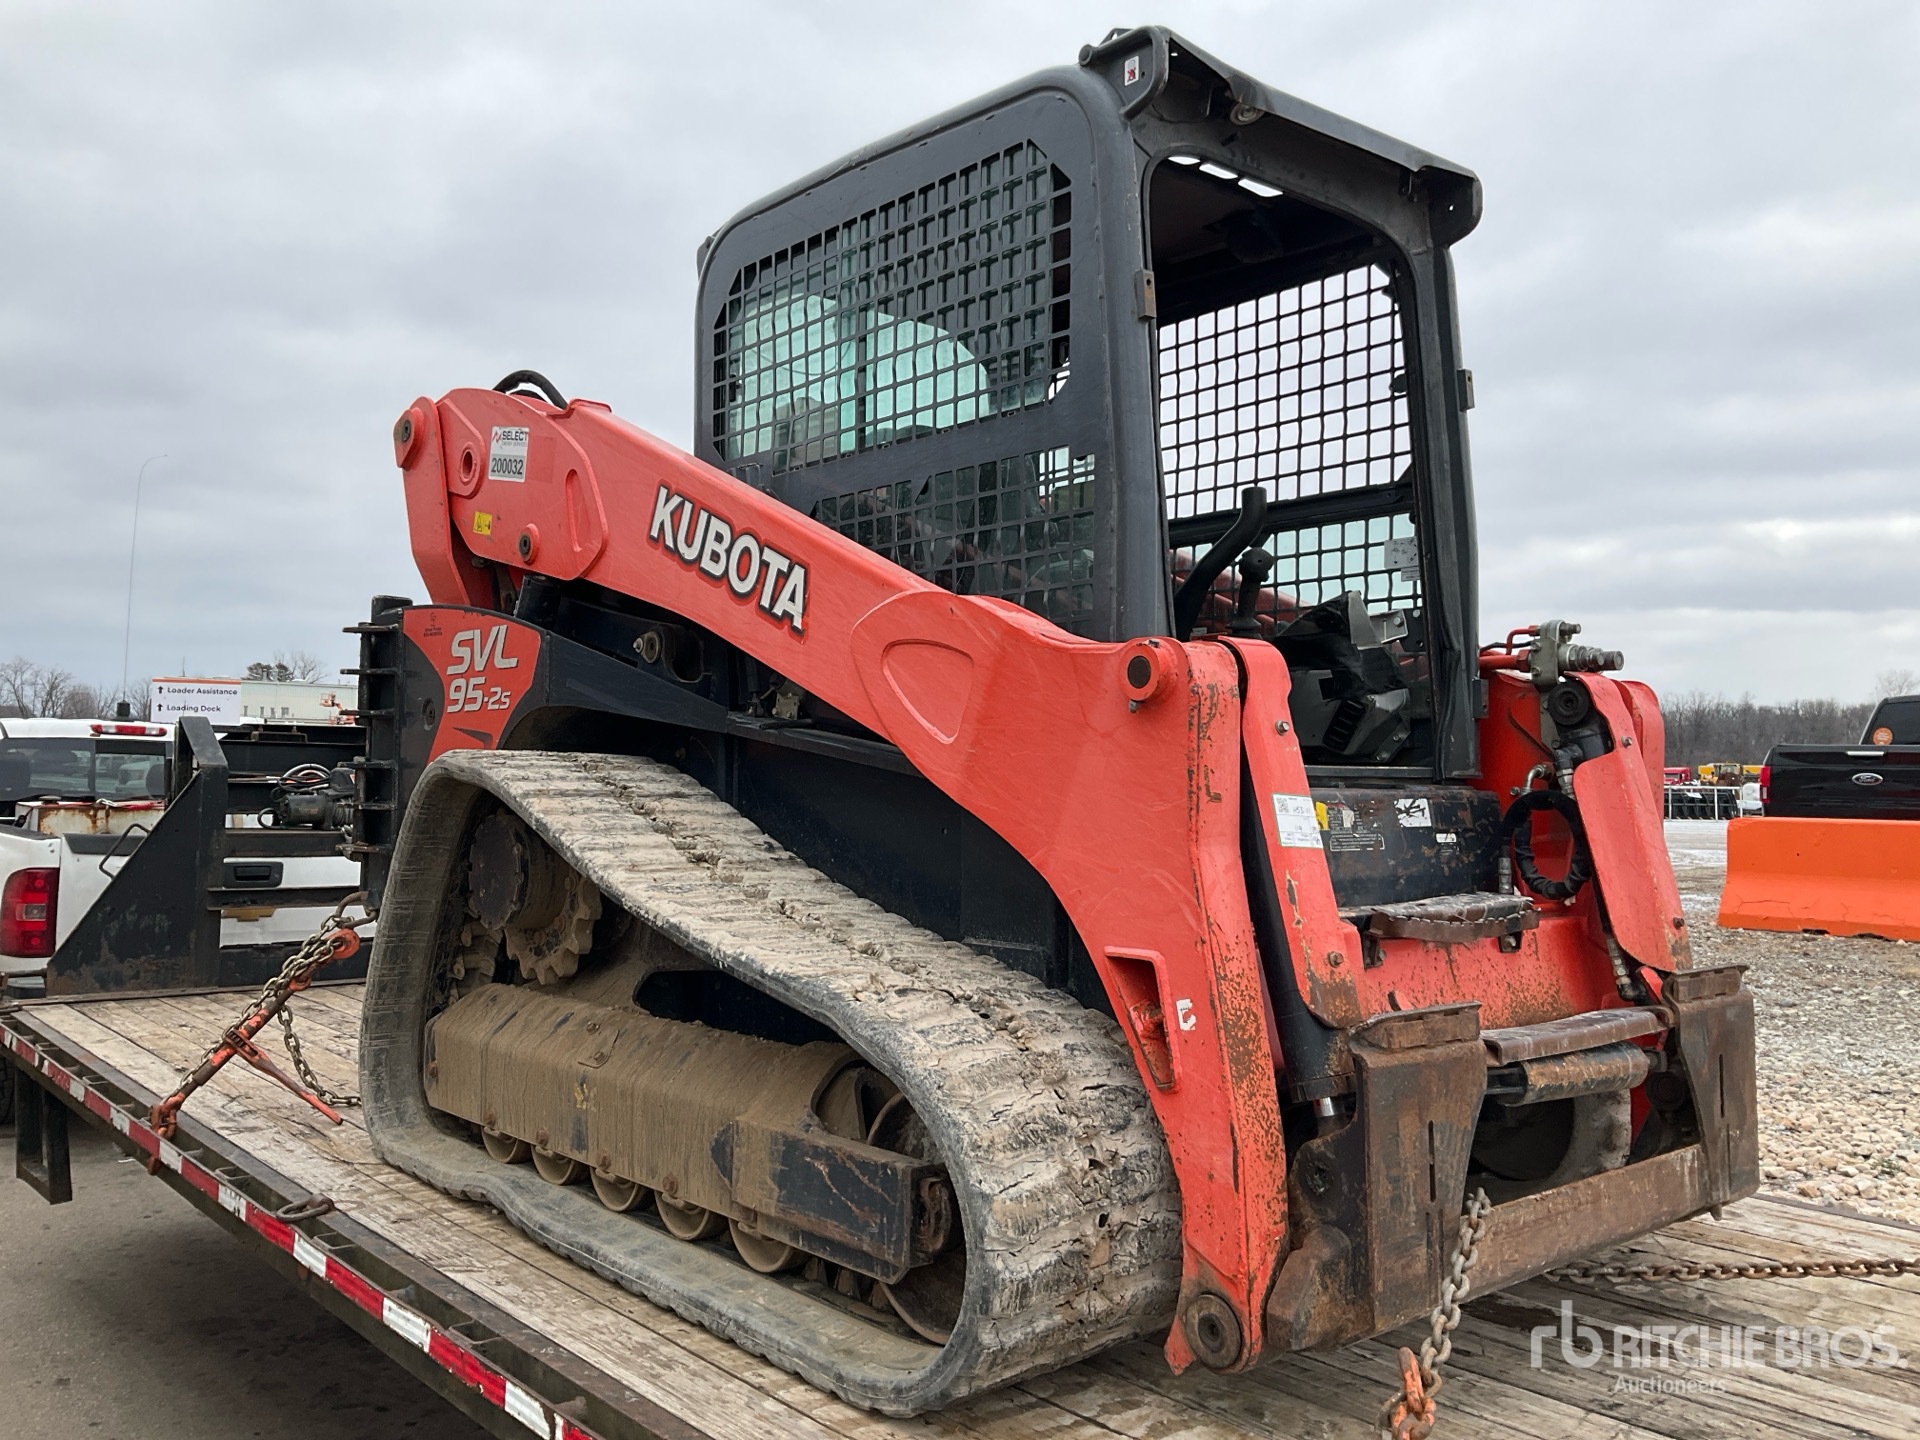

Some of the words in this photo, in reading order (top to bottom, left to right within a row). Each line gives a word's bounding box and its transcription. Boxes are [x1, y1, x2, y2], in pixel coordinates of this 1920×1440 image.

[502, 430, 529, 441] SELECT
[491, 457, 524, 475] 200032
[649, 485, 806, 631] KUBOTA
[446, 624, 519, 676] SVL
[196, 687, 238, 695] Assistance
[167, 704, 199, 713] Loading
